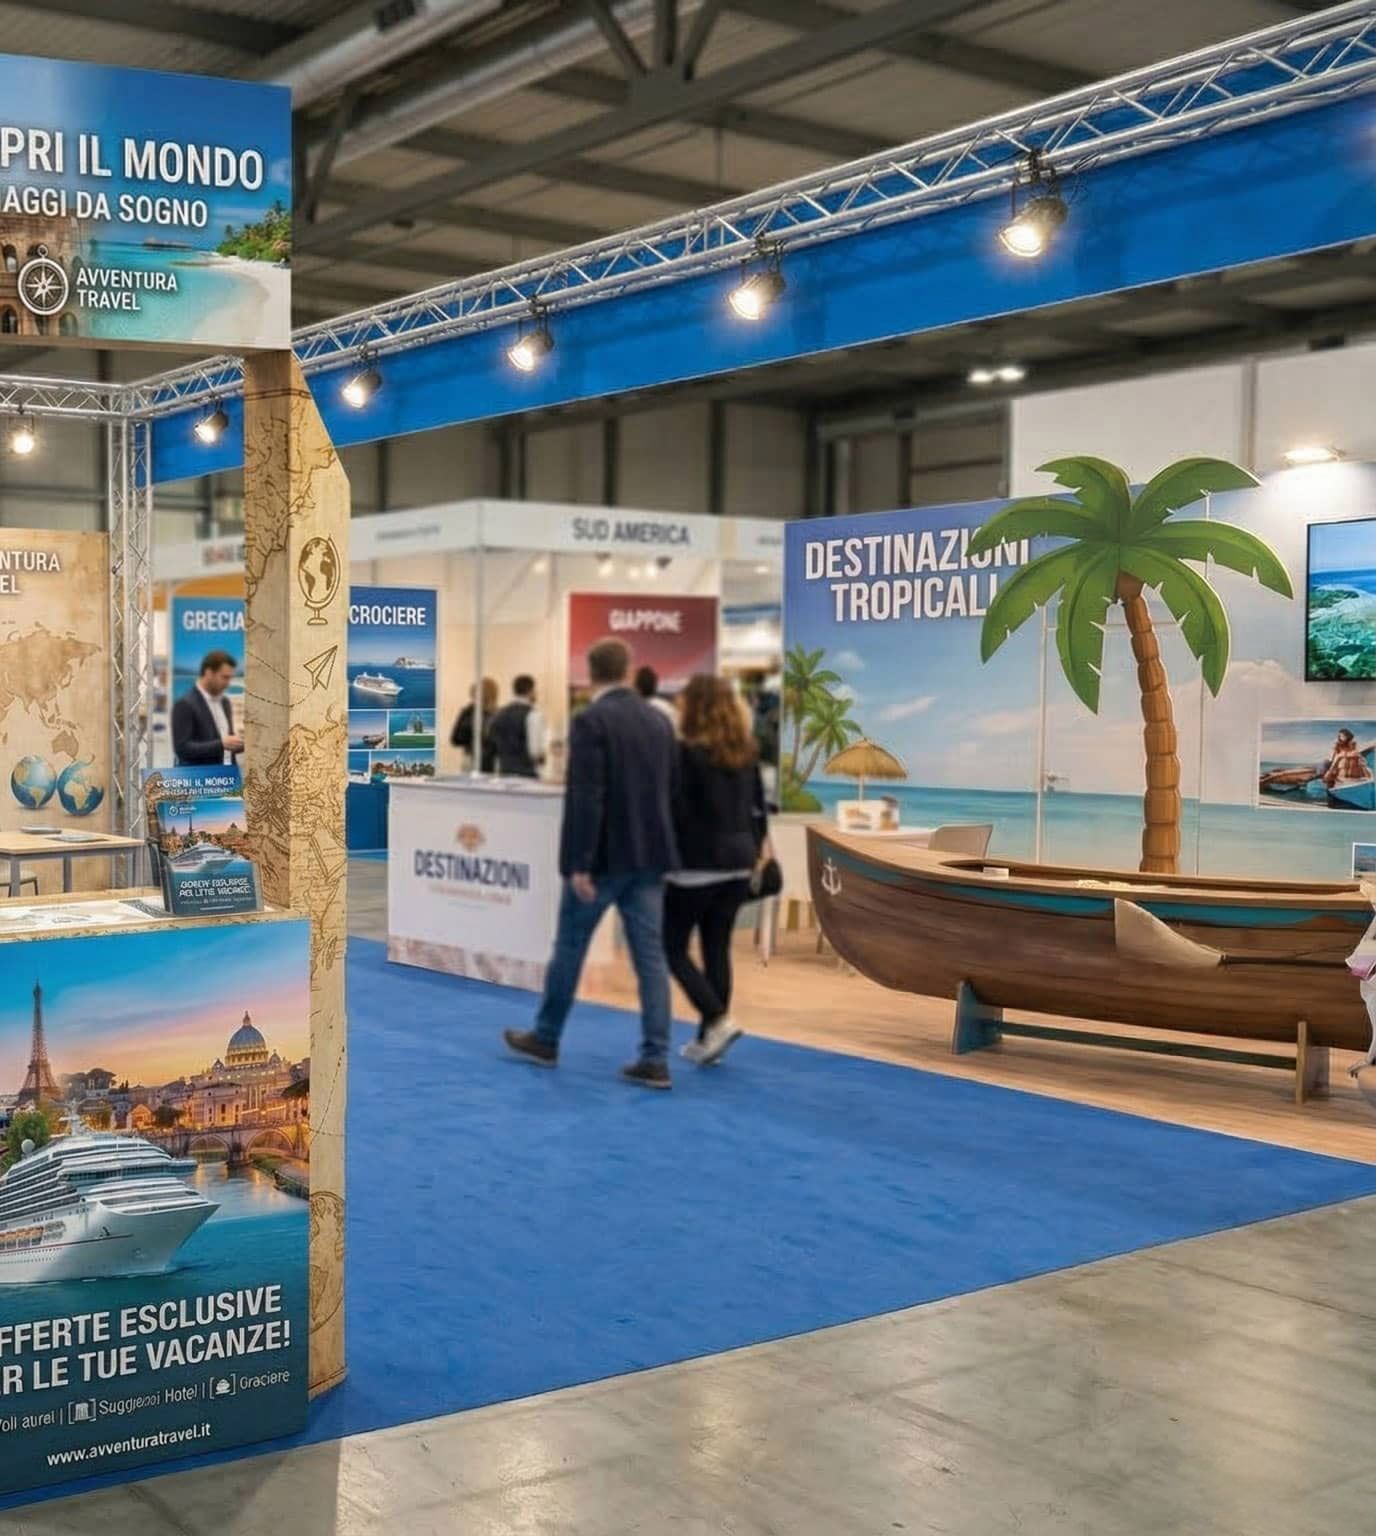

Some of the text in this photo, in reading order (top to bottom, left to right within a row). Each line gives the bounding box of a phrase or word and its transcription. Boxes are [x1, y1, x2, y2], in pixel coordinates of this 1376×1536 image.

[78, 134, 113, 178] IL
[124, 138, 265, 191] MONDO
[76, 195, 111, 222] DA
[118, 194, 208, 228] SOGNO
[76, 266, 178, 292] AVVENTURA
[78, 289, 141, 311] TRAVEL
[573, 518, 690, 545] SUD AMERICA
[183, 609, 245, 631] GRECIA
[349, 605, 426, 626] CROCIERE
[609, 609, 682, 632] GIAPPONE
[414, 850, 530, 890] DESTINAZIONI
[120, 1284, 282, 1338] ESCLUSIVE
[32, 1356, 69, 1391] LE
[78, 1345, 138, 1382] TUE
[145, 1319, 291, 1371] VACANZE!
[165, 1383, 198, 1403] Hotel
[47, 1423, 211, 1466] www.avventuratravel.it
